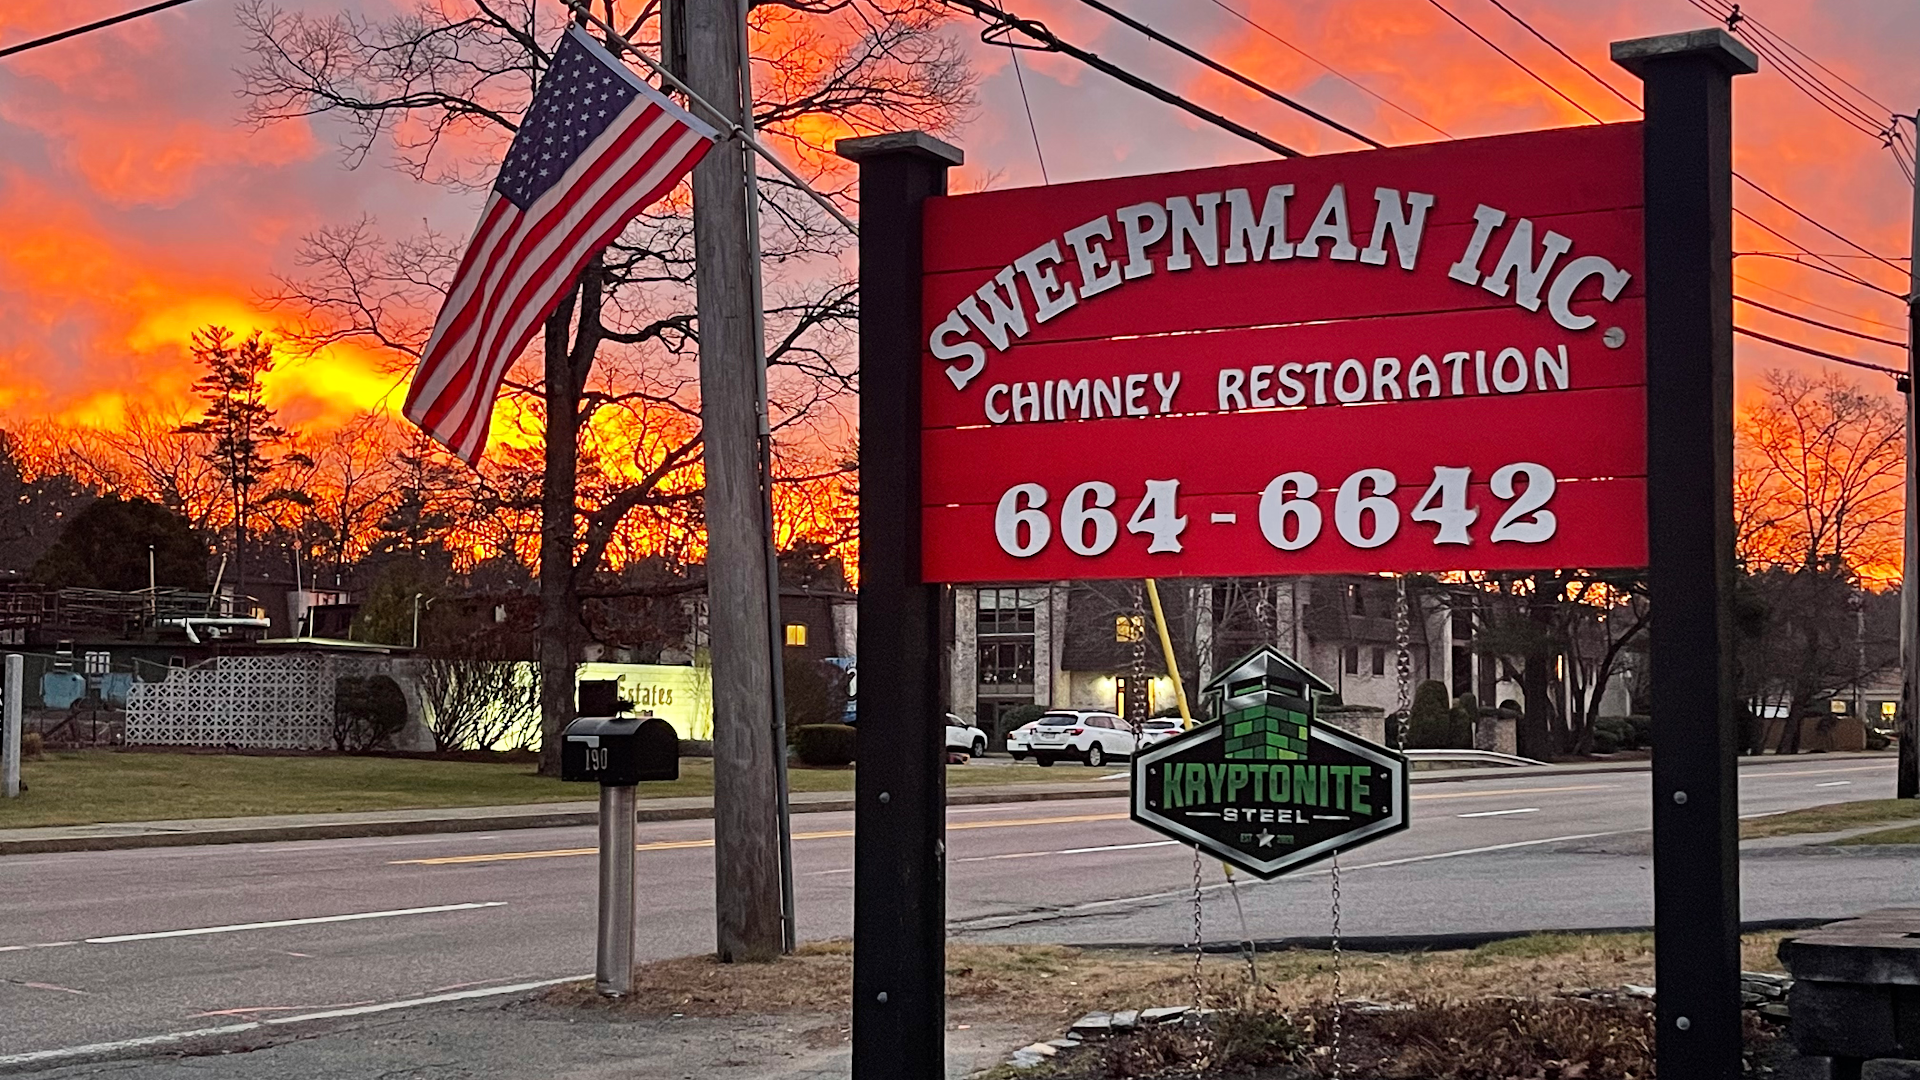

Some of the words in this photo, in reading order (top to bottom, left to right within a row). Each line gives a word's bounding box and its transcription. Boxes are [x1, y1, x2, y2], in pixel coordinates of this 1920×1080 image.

[929, 183, 1435, 390] SWEEPNMAN
[1448, 203, 1632, 349] INC.
[985, 371, 1181, 424] CHIMNEY
[1218, 344, 1570, 411] RESTORATION
[585, 747, 608, 771] 190
[1163, 762, 1373, 815] KRYPTONITE
[1223, 807, 1310, 824] STEEL
